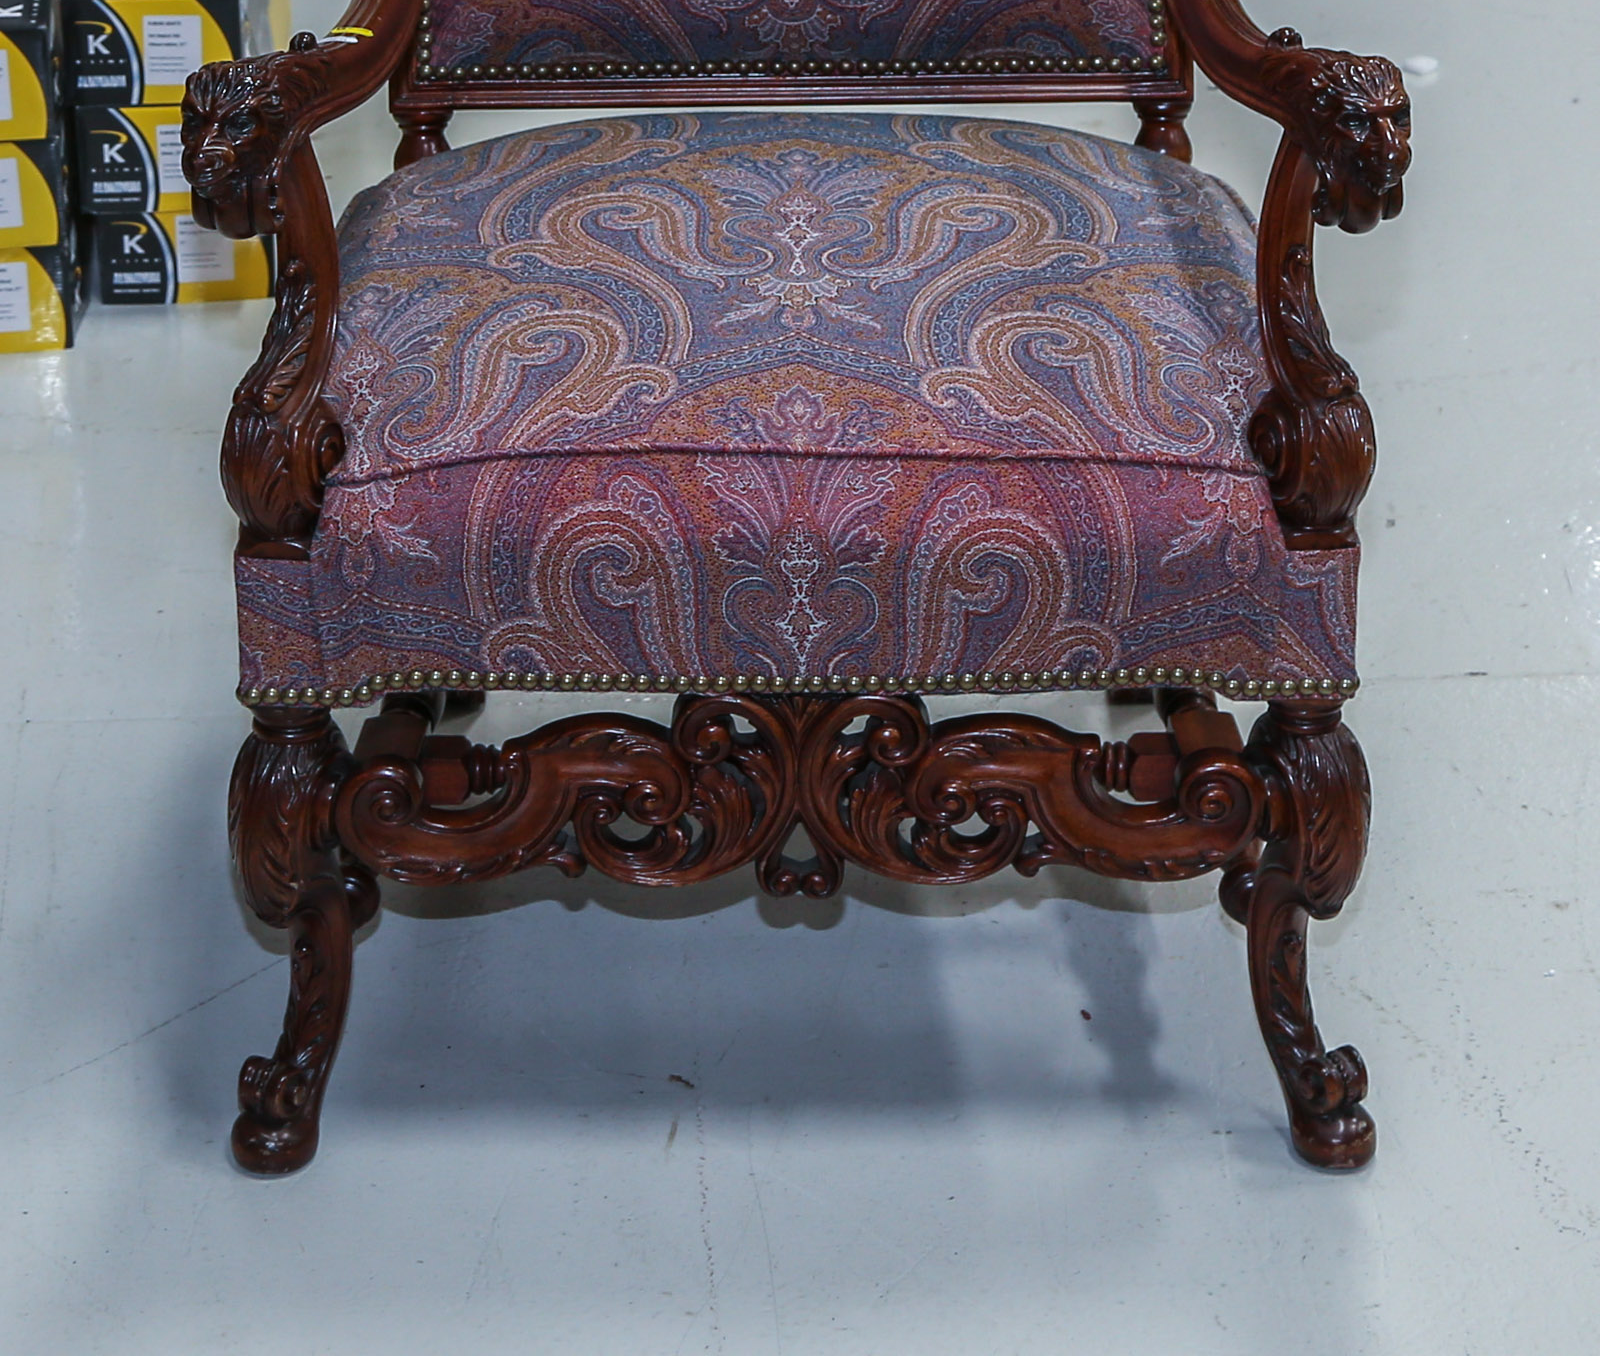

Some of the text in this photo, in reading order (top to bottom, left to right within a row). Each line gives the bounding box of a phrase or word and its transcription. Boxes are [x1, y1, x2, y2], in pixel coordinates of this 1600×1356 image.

[87, 34, 111, 55] K
[102, 143, 127, 164] K
[122, 234, 146, 255] K
